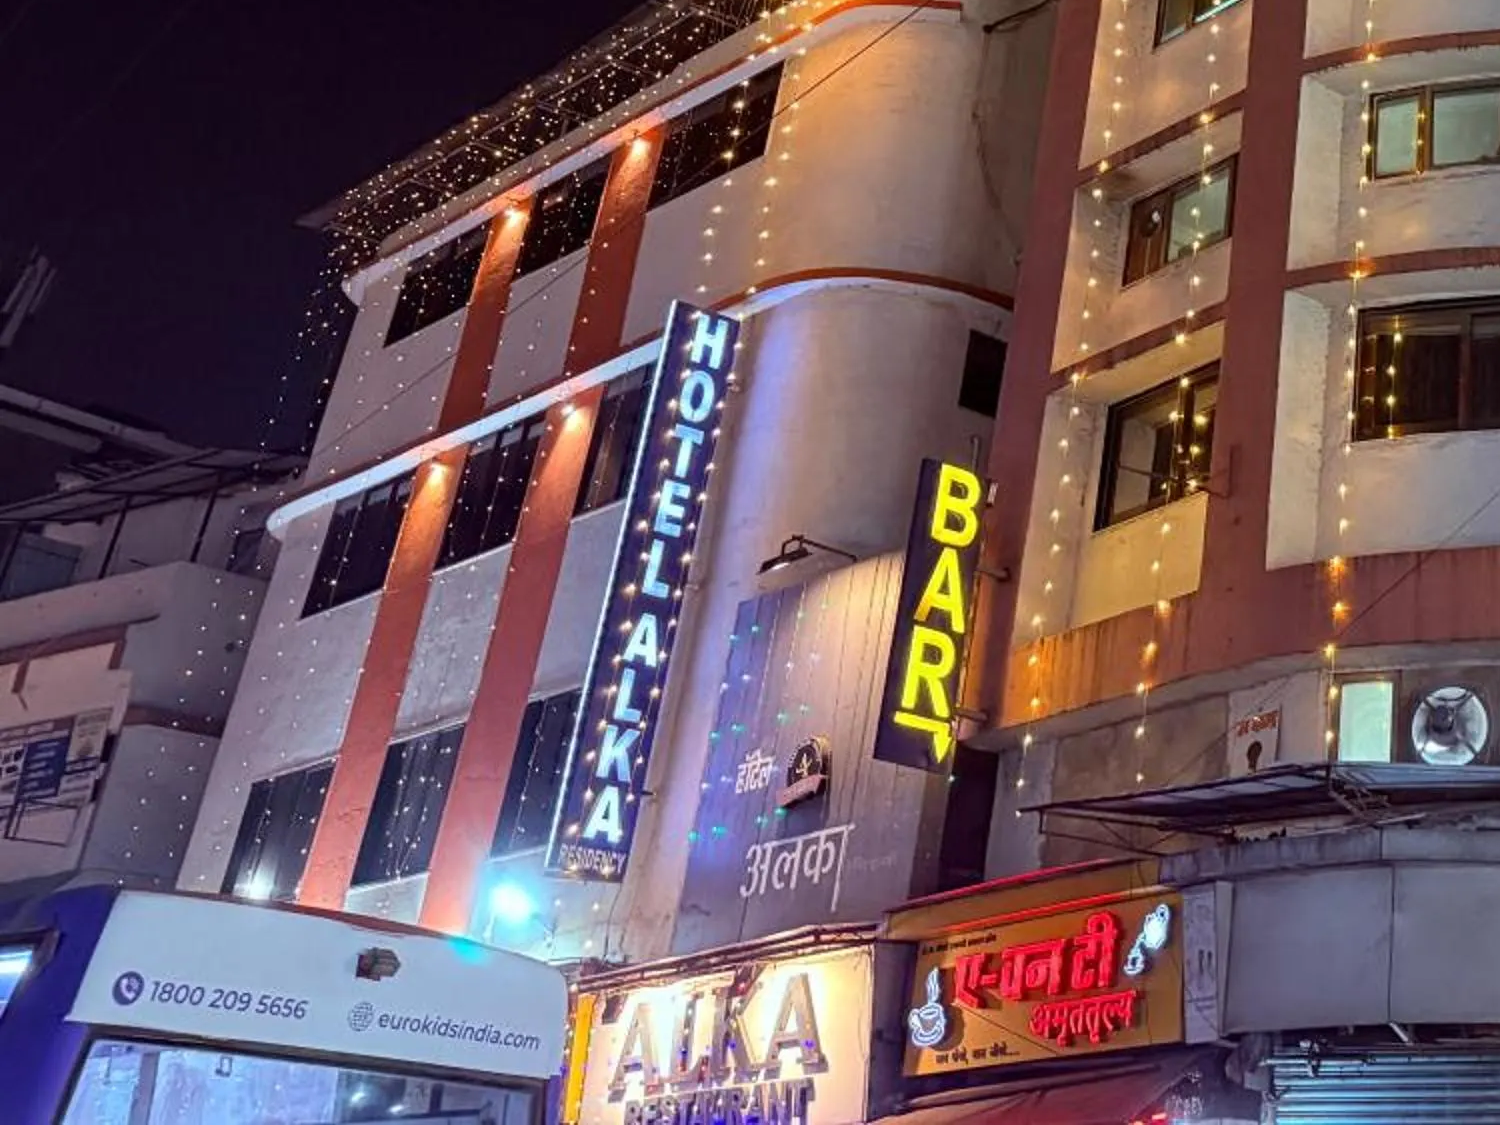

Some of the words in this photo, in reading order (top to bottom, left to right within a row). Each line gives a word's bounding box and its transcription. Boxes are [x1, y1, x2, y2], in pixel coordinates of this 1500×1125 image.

[641, 313, 727, 597] HOTEL
[901, 463, 981, 719] BAR
[582, 612, 658, 842] ALKA
[740, 823, 856, 912] अलका
[150, 979, 204, 1007] 1800
[209, 987, 251, 1013] 209
[256, 993, 308, 1020] 5656
[378, 1008, 541, 1052] eurokidsindia.com
